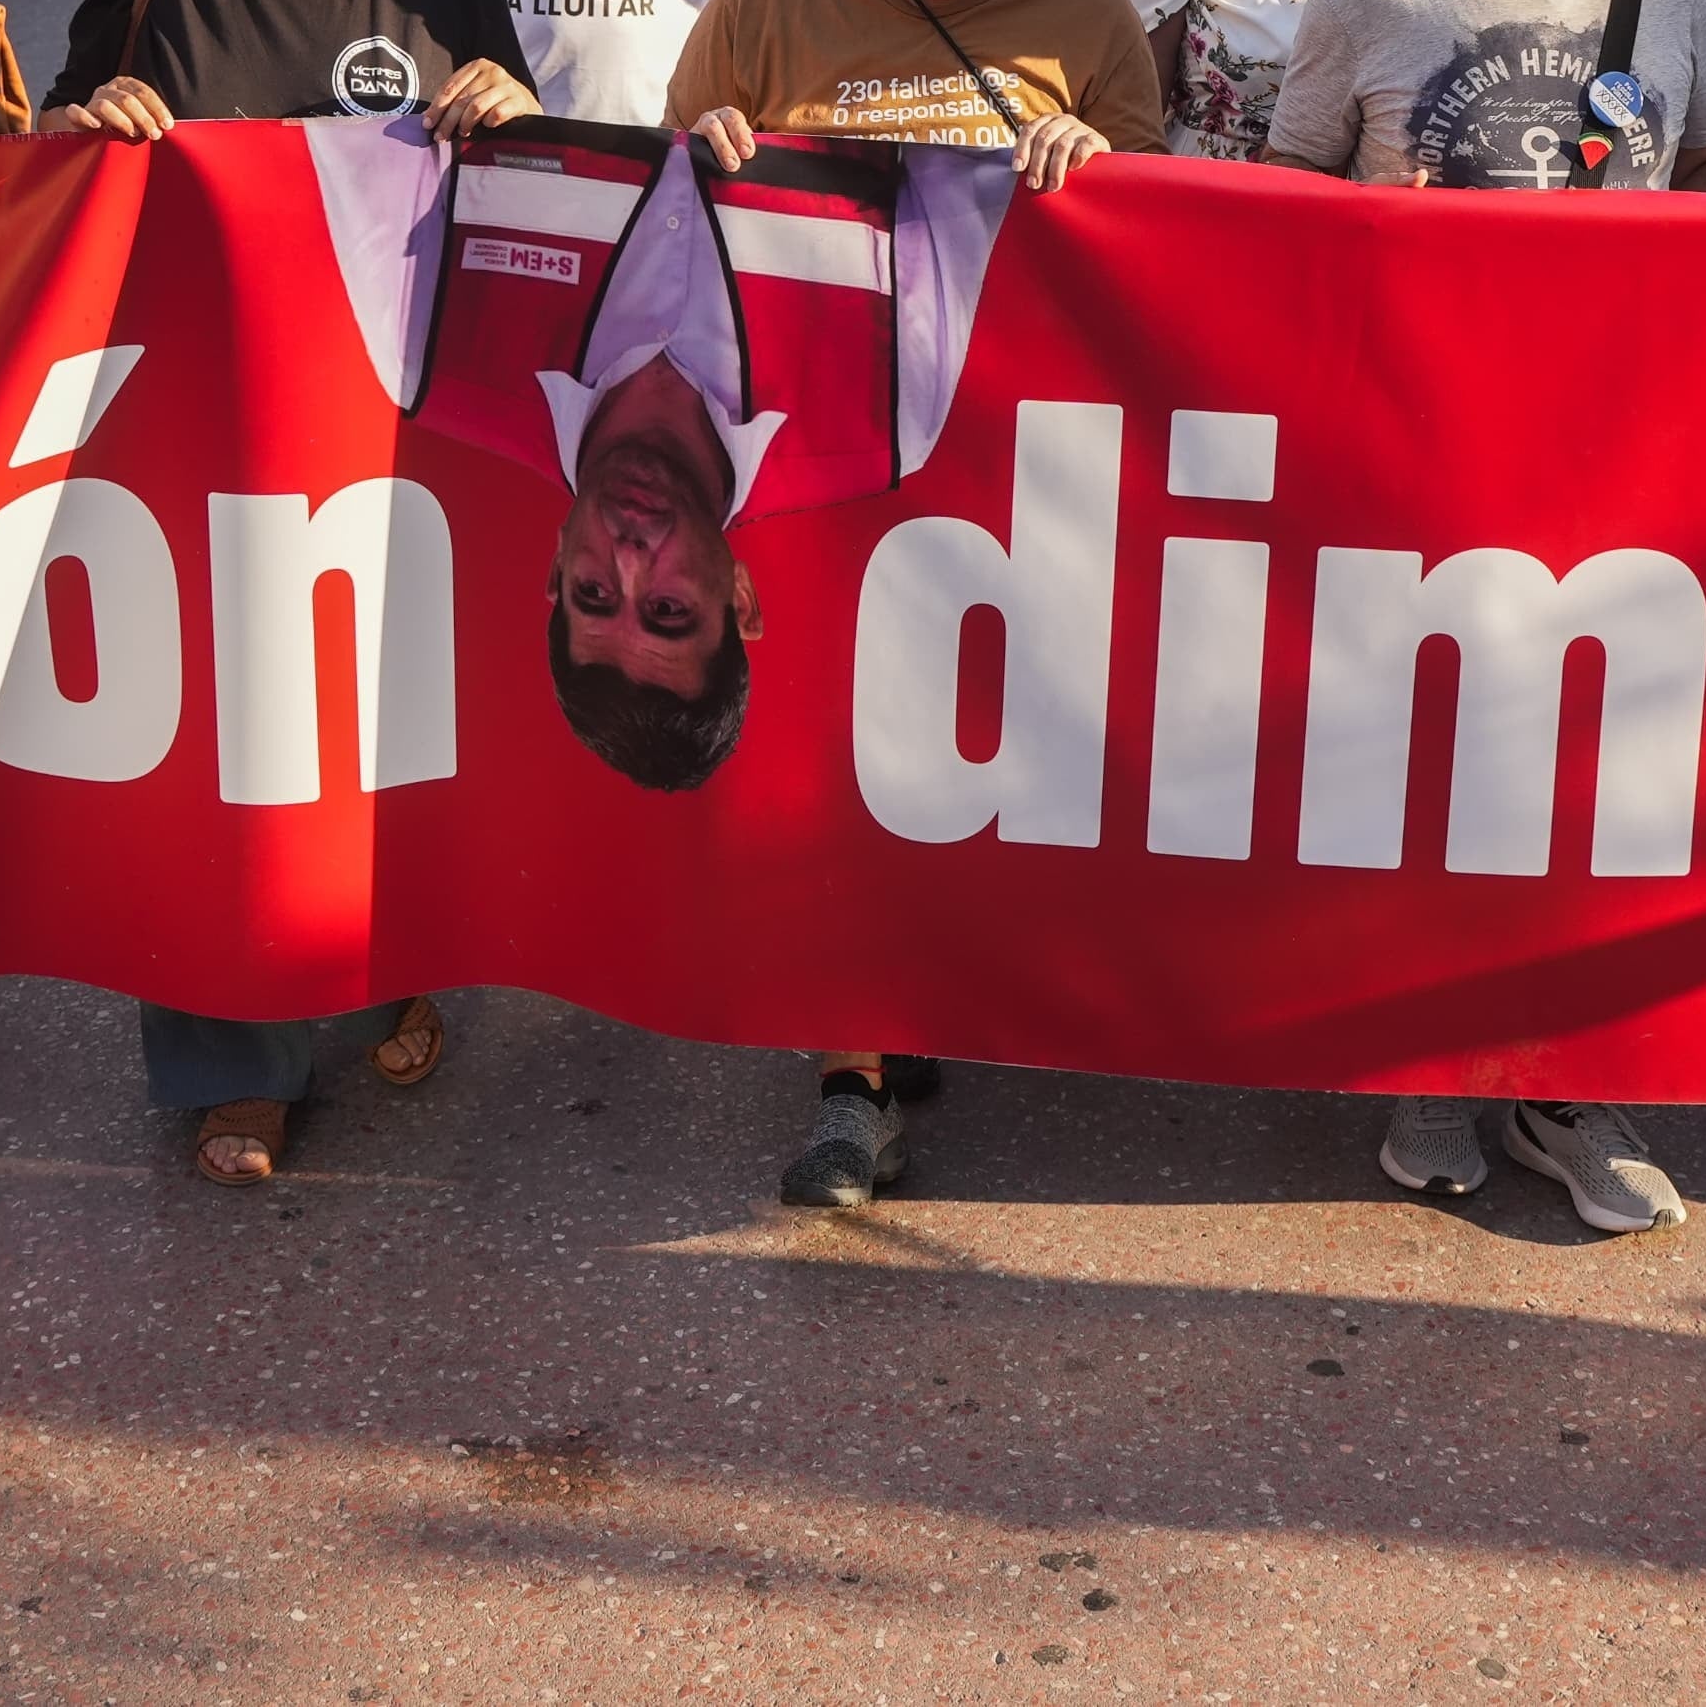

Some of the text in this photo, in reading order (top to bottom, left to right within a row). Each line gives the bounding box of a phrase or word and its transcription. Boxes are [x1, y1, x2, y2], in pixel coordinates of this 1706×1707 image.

[351, 78, 403, 97] DANA
[837, 79, 883, 105] 230
[856, 95, 1023, 126] responsables
[1416, 55, 1512, 183] NORTHERN
